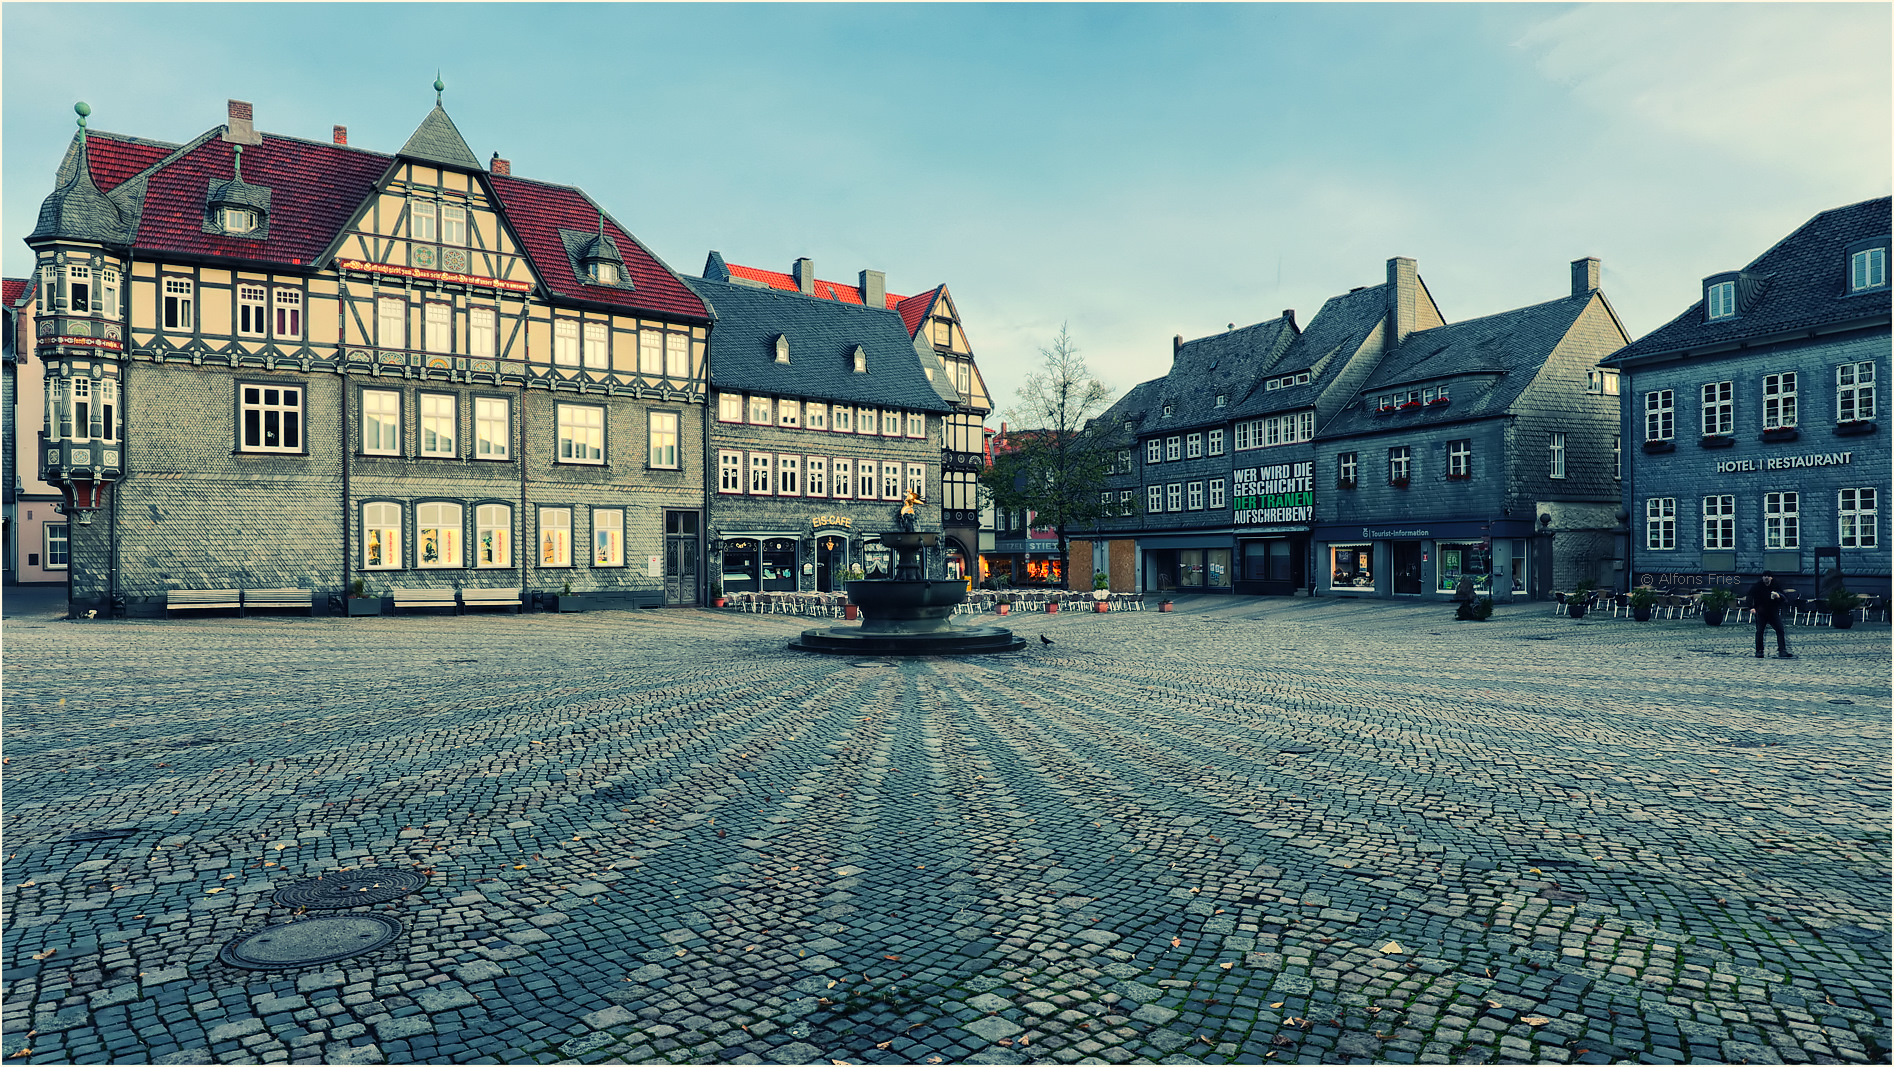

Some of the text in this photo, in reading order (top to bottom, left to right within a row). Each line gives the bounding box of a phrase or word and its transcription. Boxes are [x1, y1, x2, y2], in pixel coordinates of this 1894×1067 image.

[1717, 459, 1756, 473] HOTEL
[1767, 452, 1852, 470] RESTAURANT
[1233, 462, 1313, 484] WER WIRD DIE
[1233, 477, 1313, 497] GESCHICHTE
[1233, 491, 1313, 511] DER TRÄNEN
[812, 515, 852, 528] EIS-CAFE
[1233, 506, 1313, 525] AUFSCHREIBEN?
[1371, 528, 1429, 538] Tourist-Information
